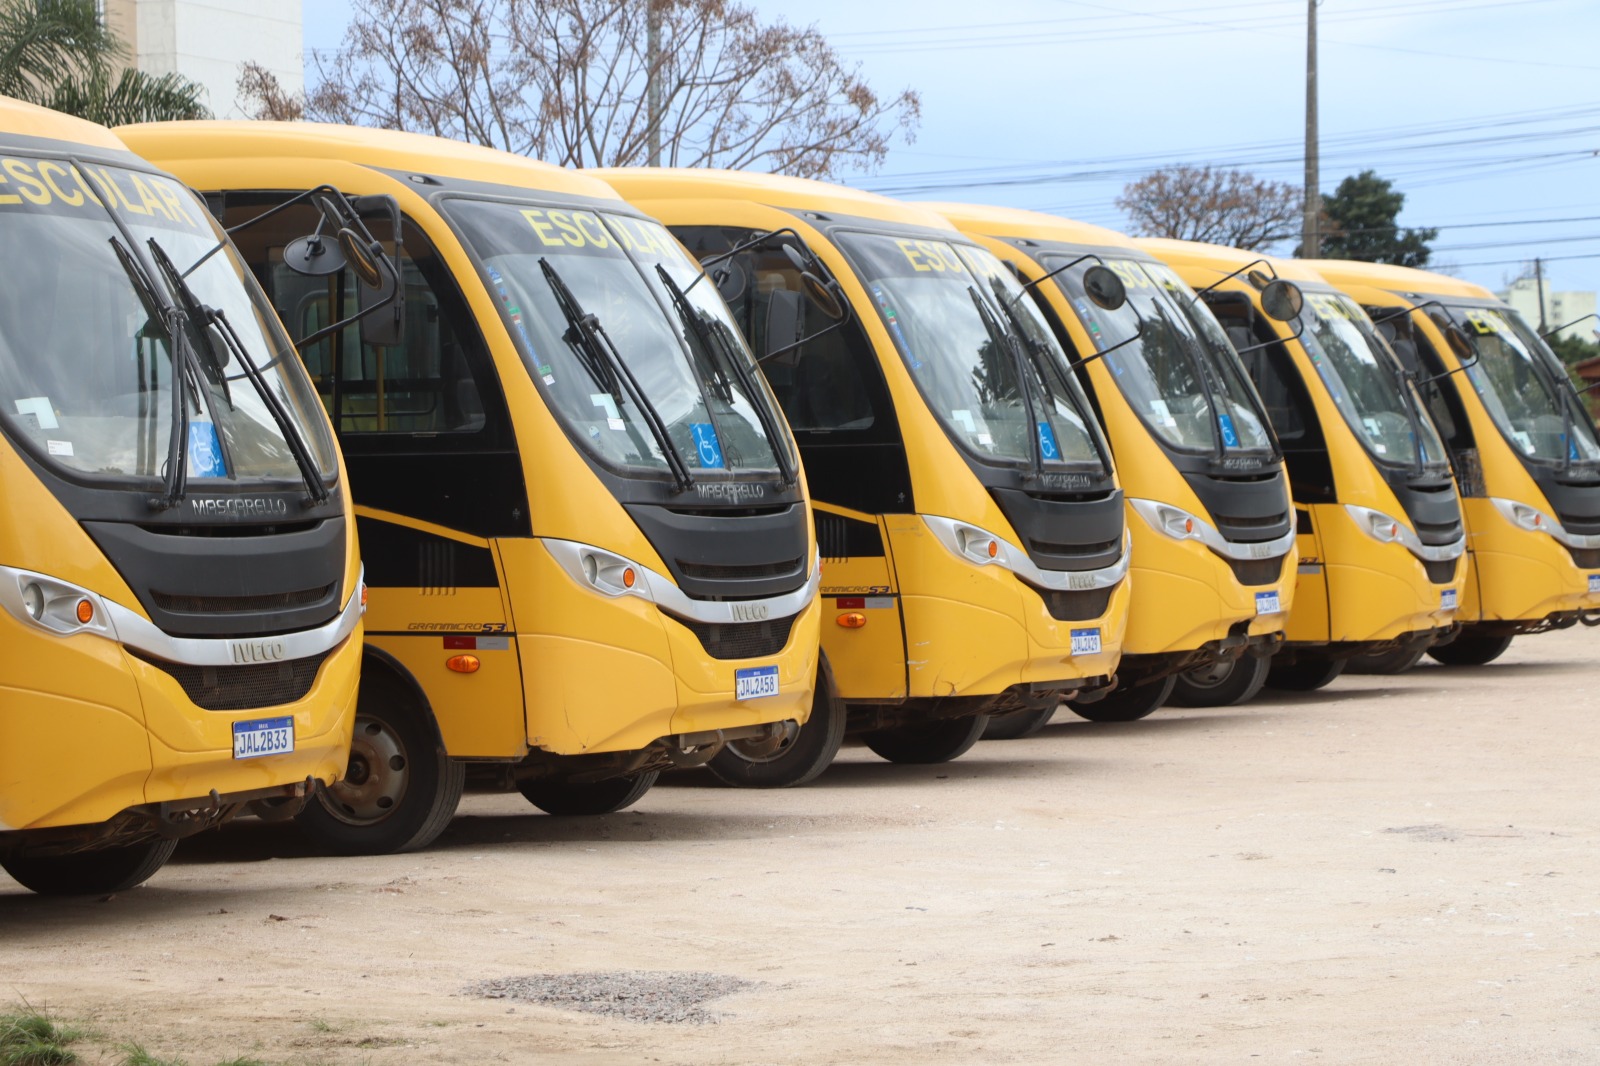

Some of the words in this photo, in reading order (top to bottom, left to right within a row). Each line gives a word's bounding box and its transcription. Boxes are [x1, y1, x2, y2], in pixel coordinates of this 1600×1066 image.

[697, 484, 764, 499] MASCARELLO
[192, 498, 287, 516] MASCARELLO
[233, 640, 285, 663] IVECO
[740, 675, 775, 697] JAL2A58
[239, 728, 288, 754] JAL2B33
